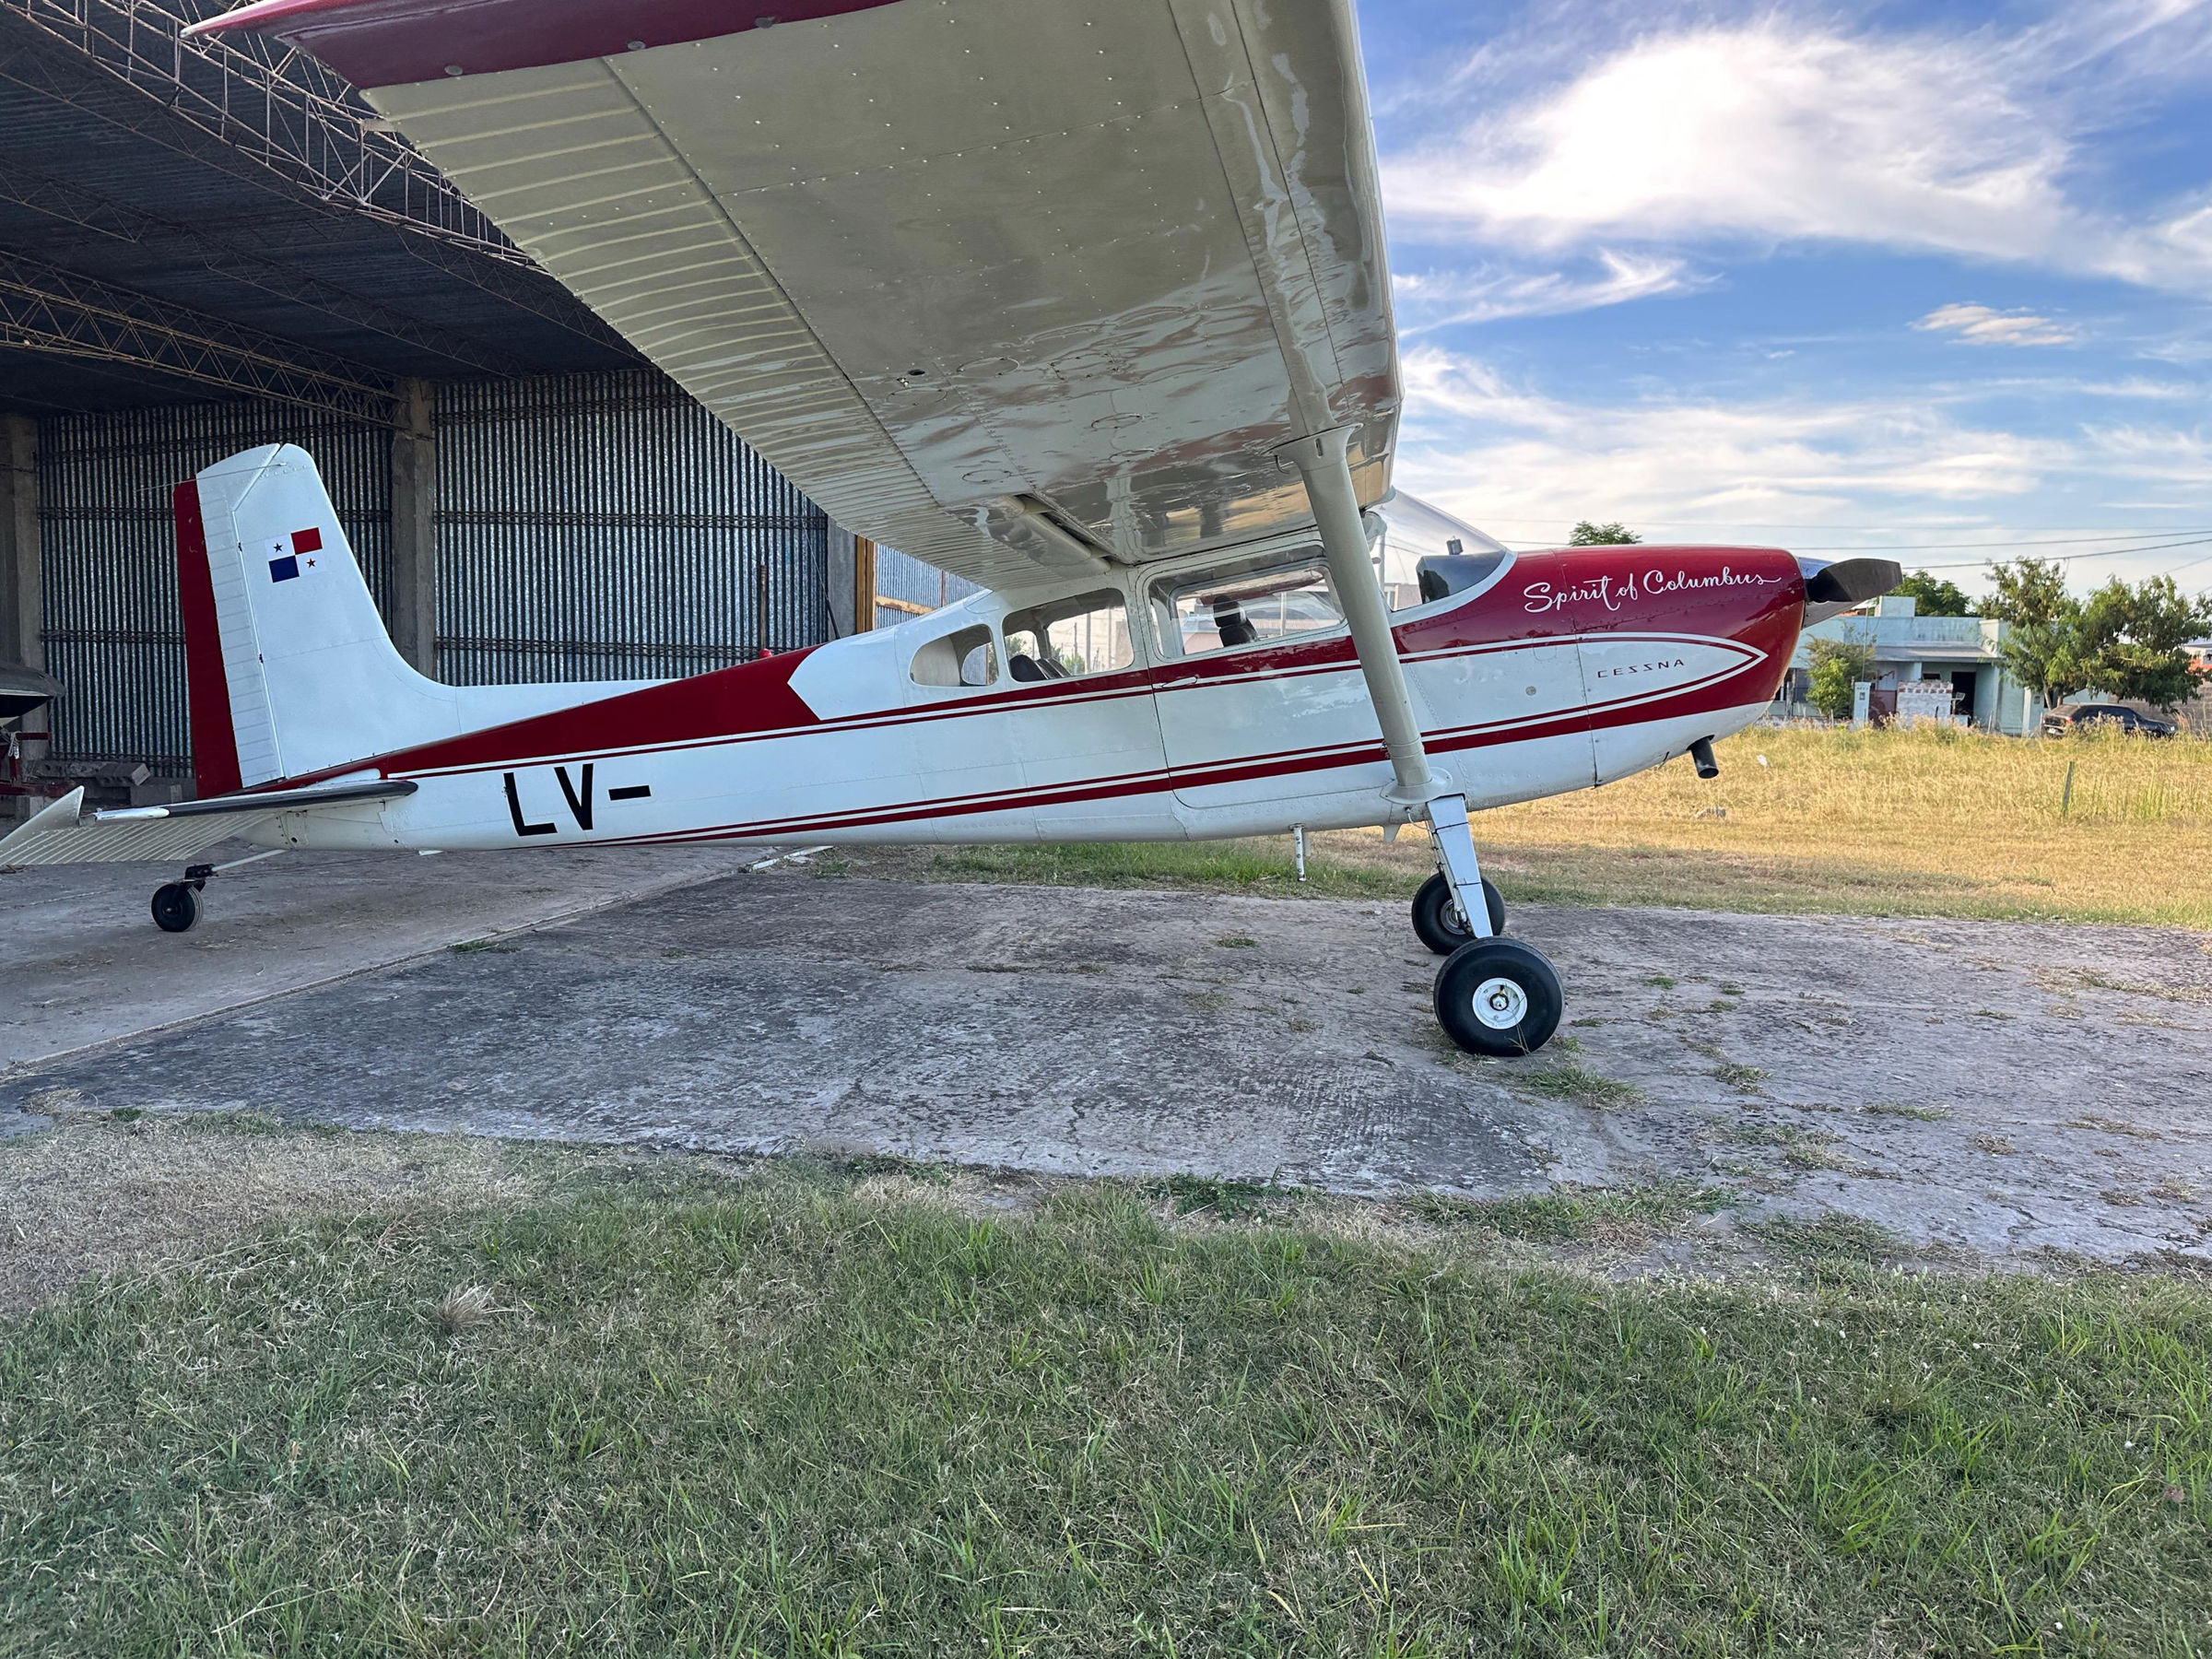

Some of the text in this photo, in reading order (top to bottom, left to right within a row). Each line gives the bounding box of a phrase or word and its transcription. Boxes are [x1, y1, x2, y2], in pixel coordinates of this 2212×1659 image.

[1523, 566, 1782, 613] Spirit of Columbus
[1597, 658, 1685, 678] CESSNA
